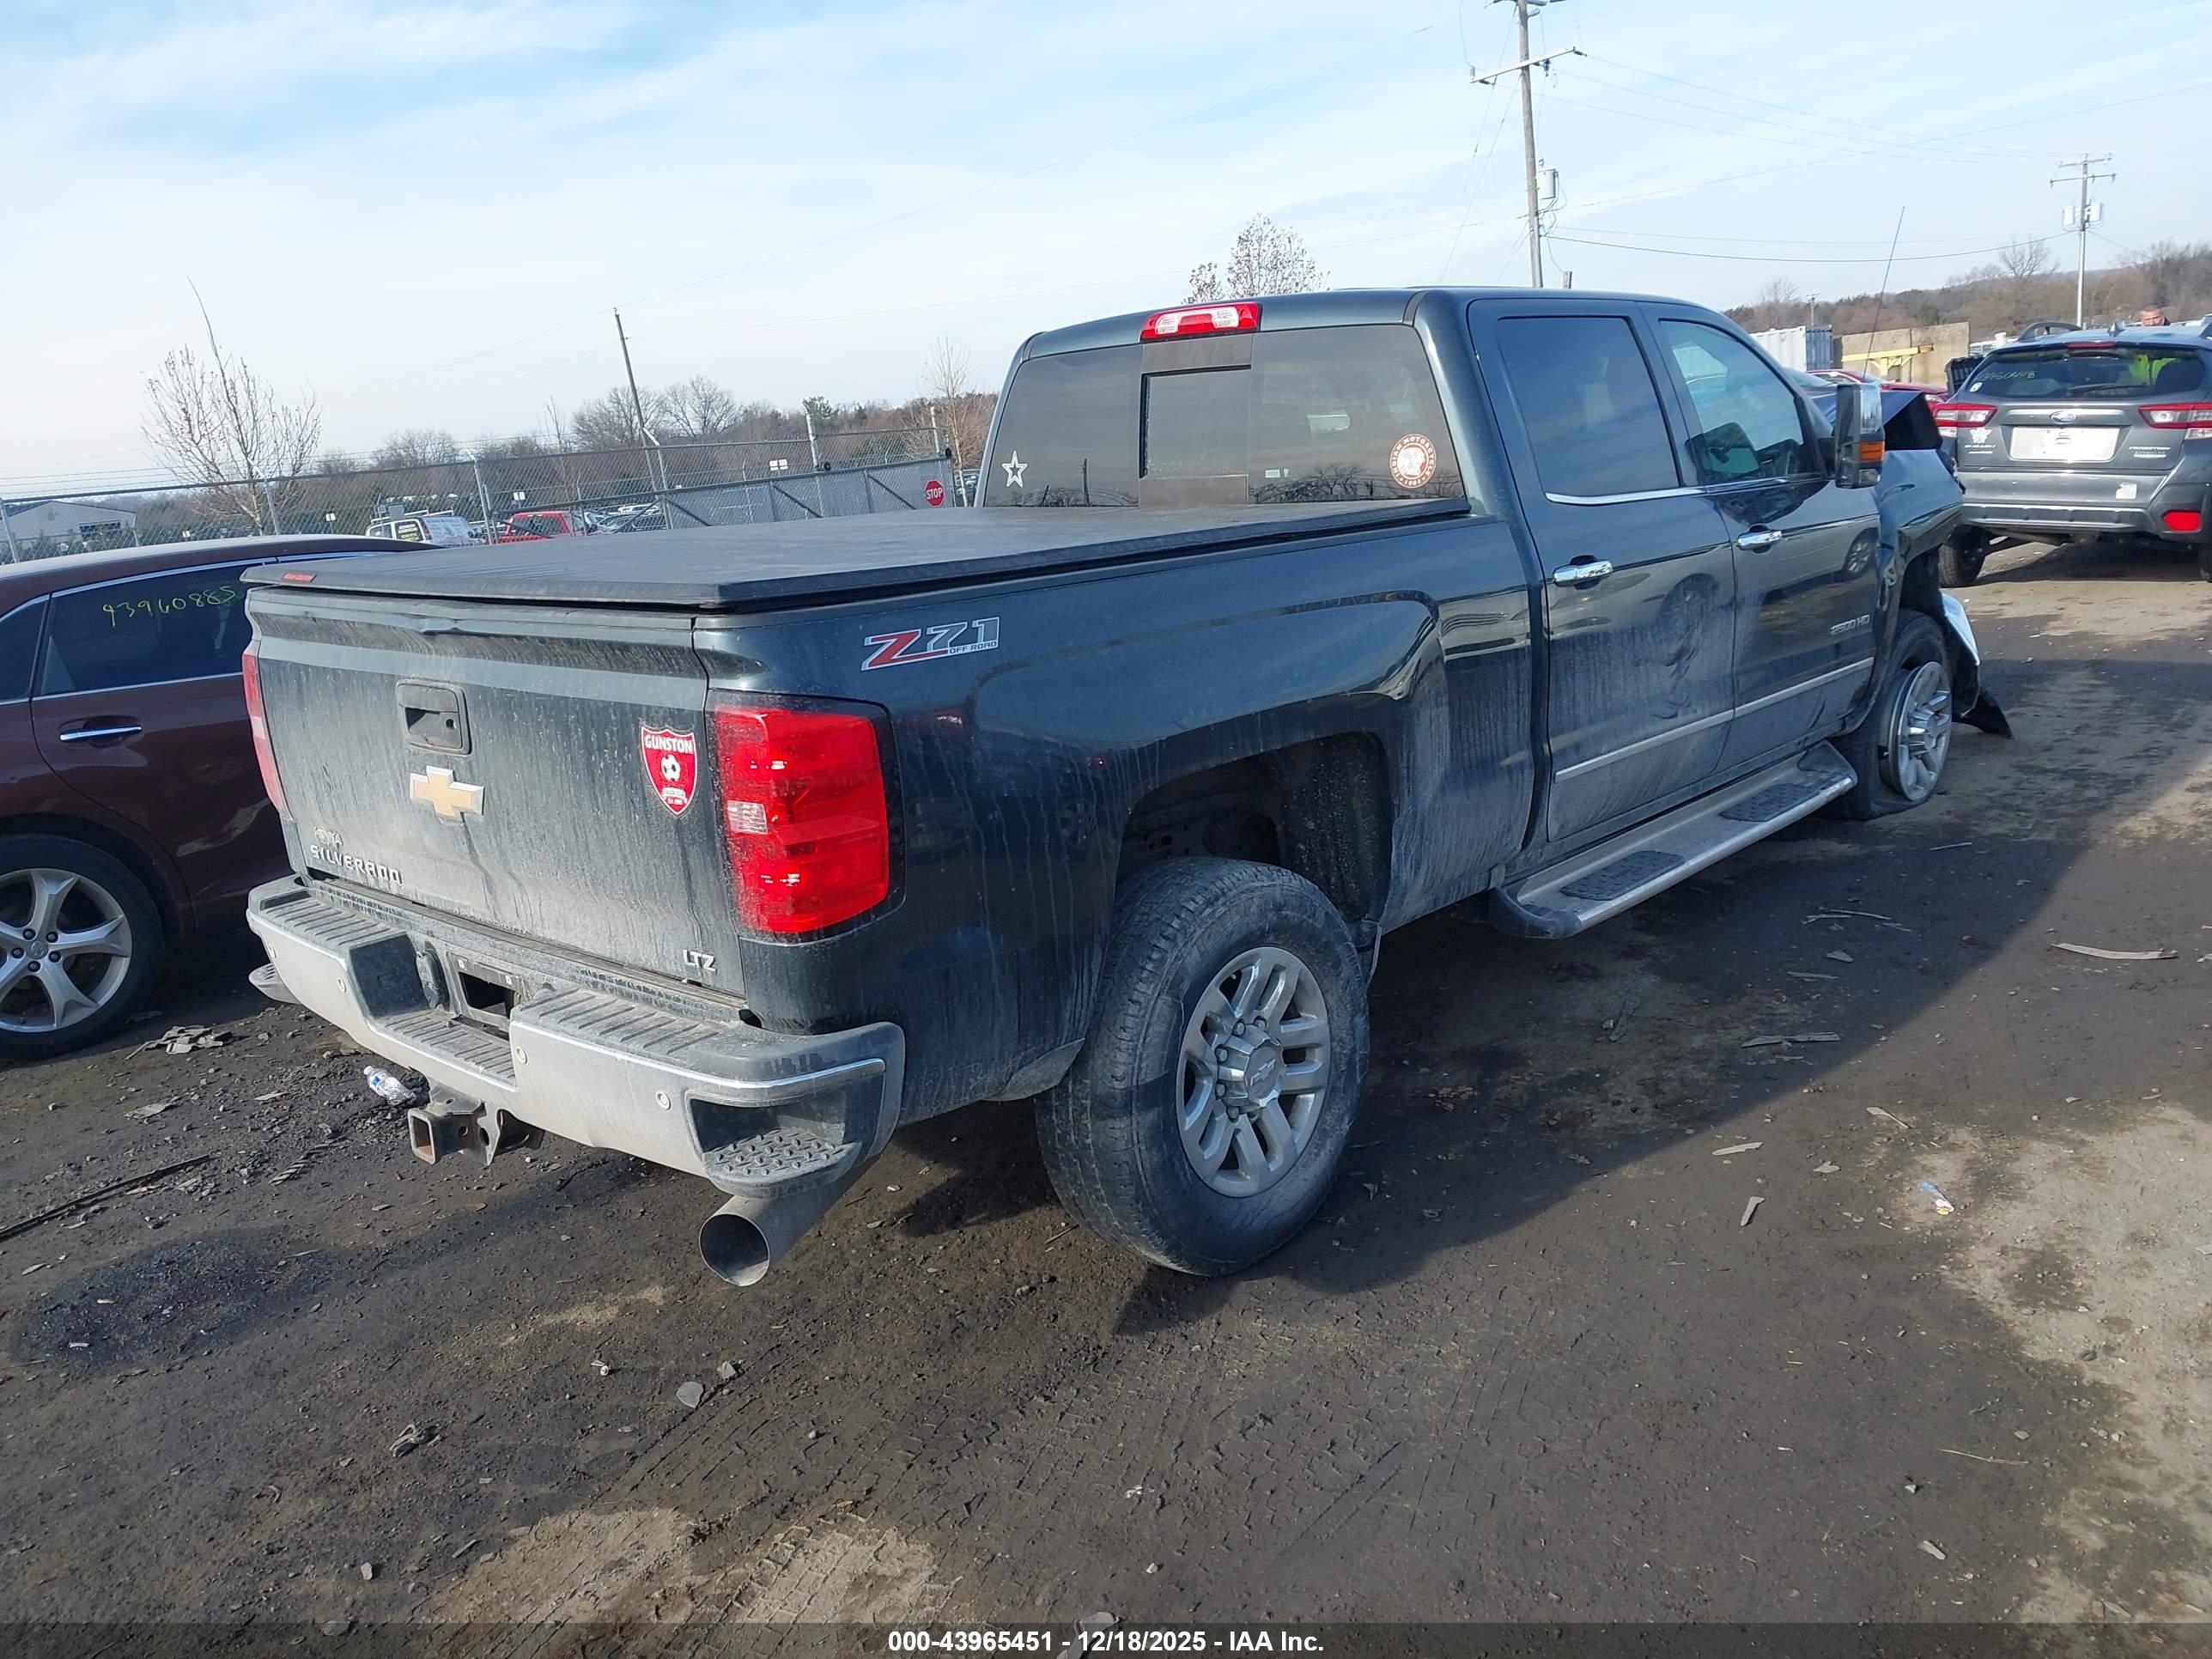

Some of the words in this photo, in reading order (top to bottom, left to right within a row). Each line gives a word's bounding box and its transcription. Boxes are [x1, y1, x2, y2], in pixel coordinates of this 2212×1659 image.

[1392, 443, 1402, 477] INDIAN
[1403, 435, 1435, 476] MOTORCYCLE
[926, 487, 943, 500] STOP
[1856, 614, 1870, 626] HD
[860, 617, 1000, 672] Z71
[970, 641, 997, 651] ROAD
[645, 734, 693, 754] GUNSTON
[310, 844, 404, 886] SILVERADO
[682, 949, 718, 974] LTZ
